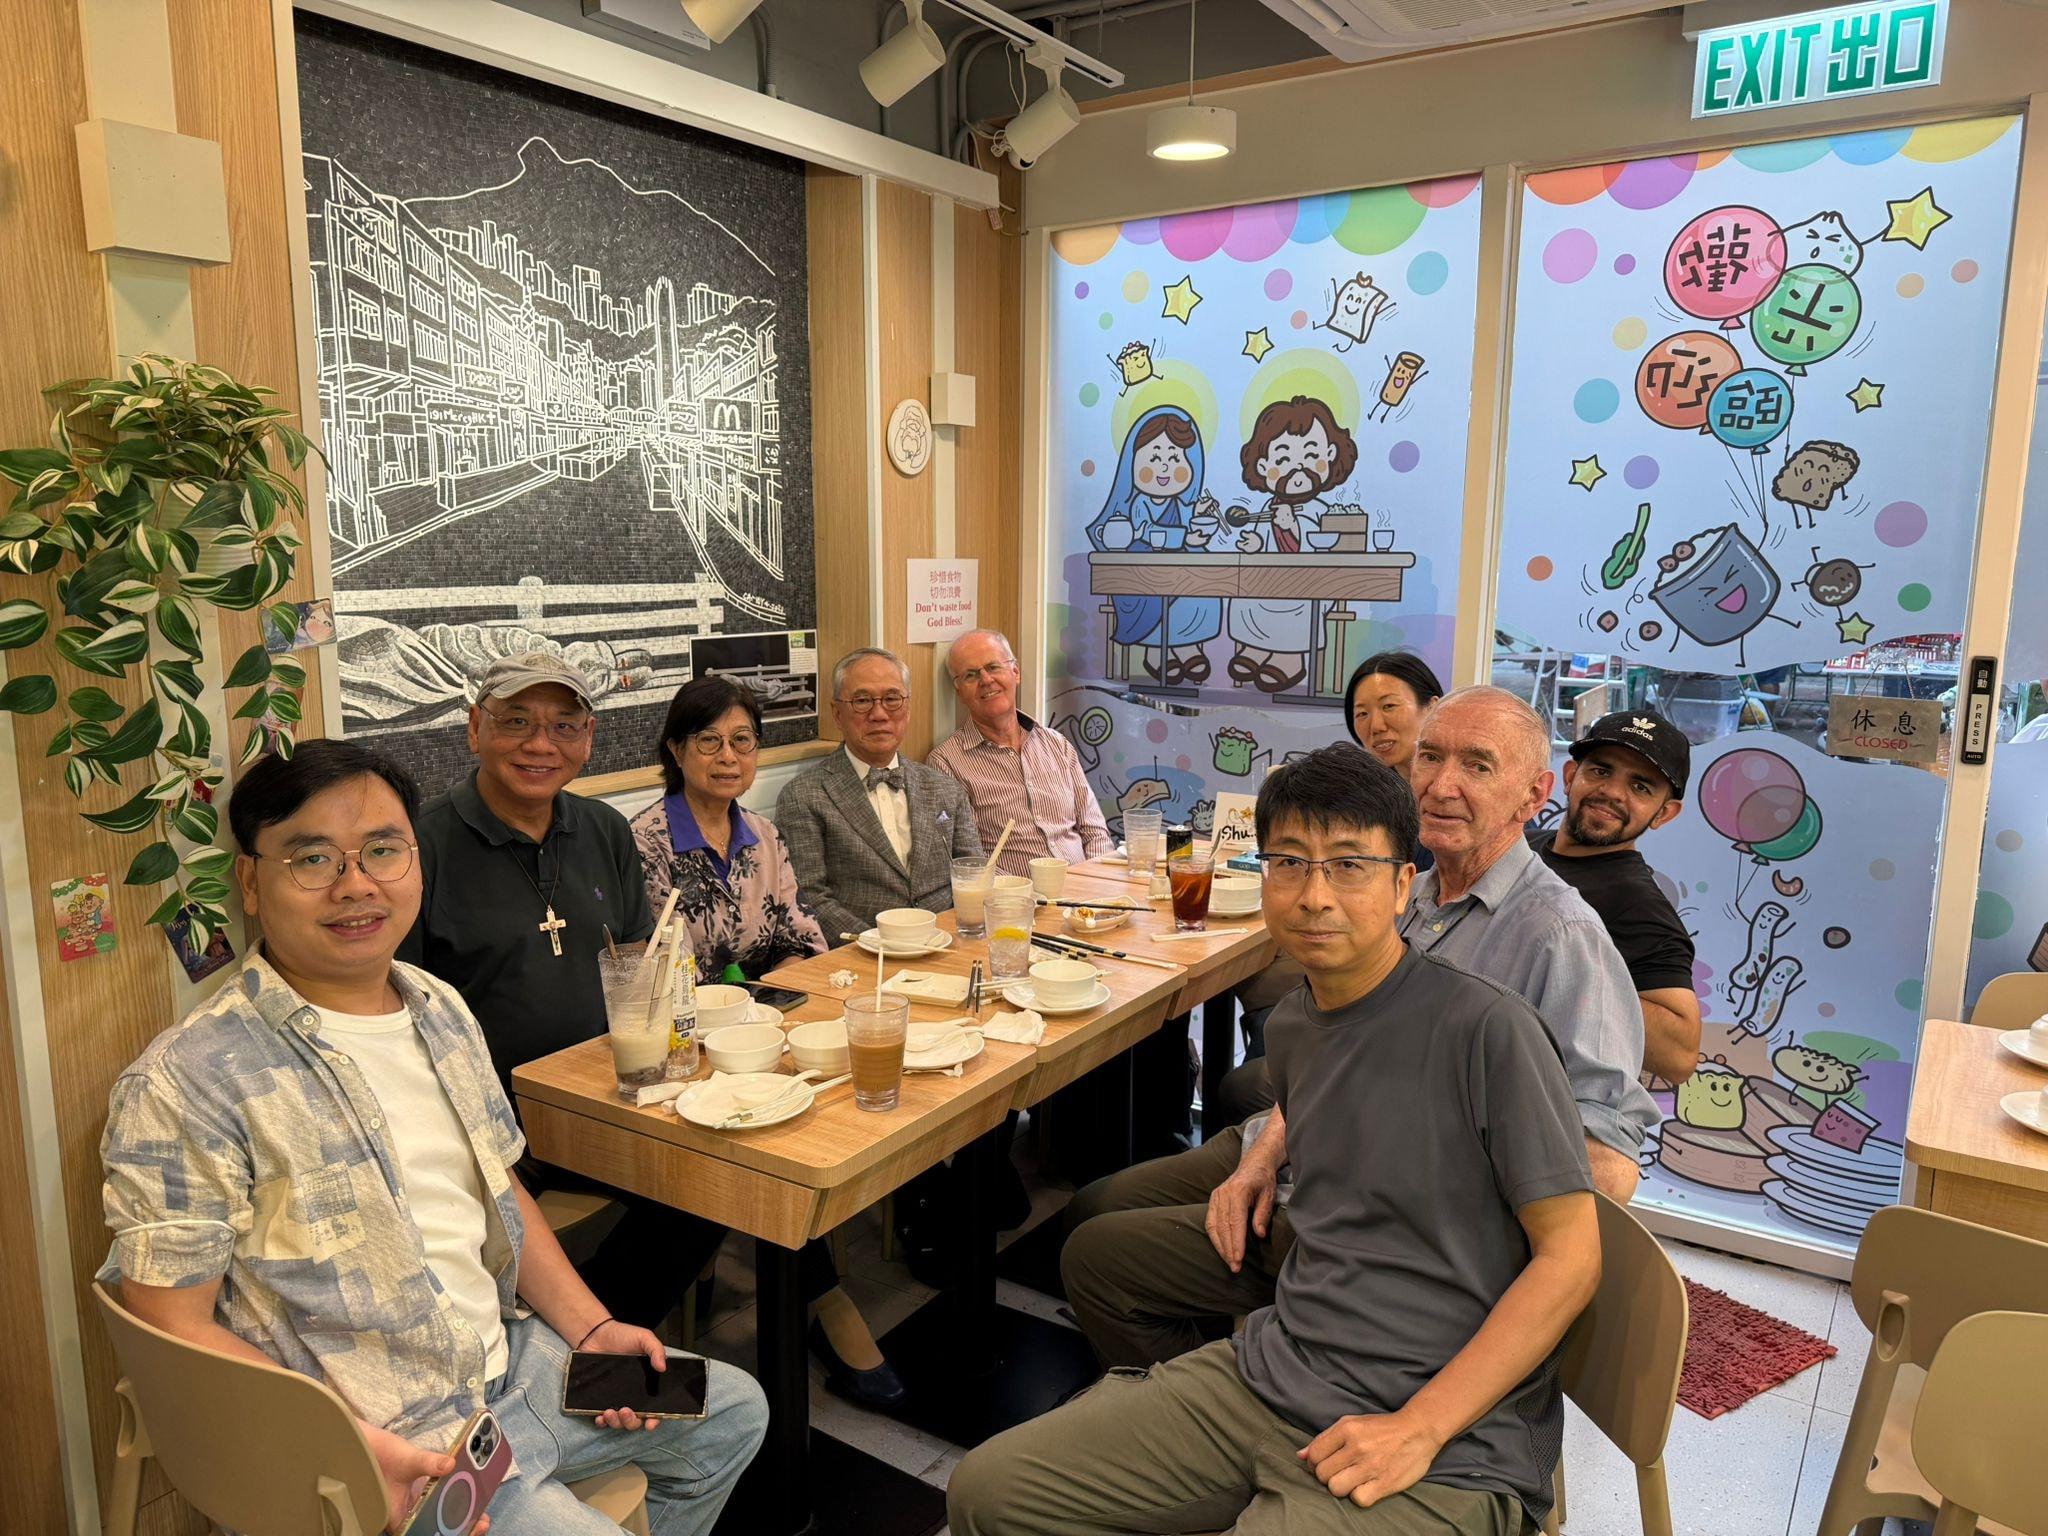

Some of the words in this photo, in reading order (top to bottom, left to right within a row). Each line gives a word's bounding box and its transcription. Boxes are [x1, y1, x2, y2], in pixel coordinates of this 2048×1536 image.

[1702, 22, 1822, 112] EXIT
[1826, 3, 1937, 96] 出口
[915, 602, 937, 613] Don't
[939, 602, 957, 611] waste
[959, 601, 972, 611] food
[927, 617, 943, 627] God
[945, 616, 963, 626] Bless!
[1976, 669, 1988, 688] 自動
[1851, 709, 1917, 736] 休息
[1972, 703, 1982, 745] PRESS
[1621, 725, 1654, 741] adidas
[1854, 736, 1908, 750] CLOSED
